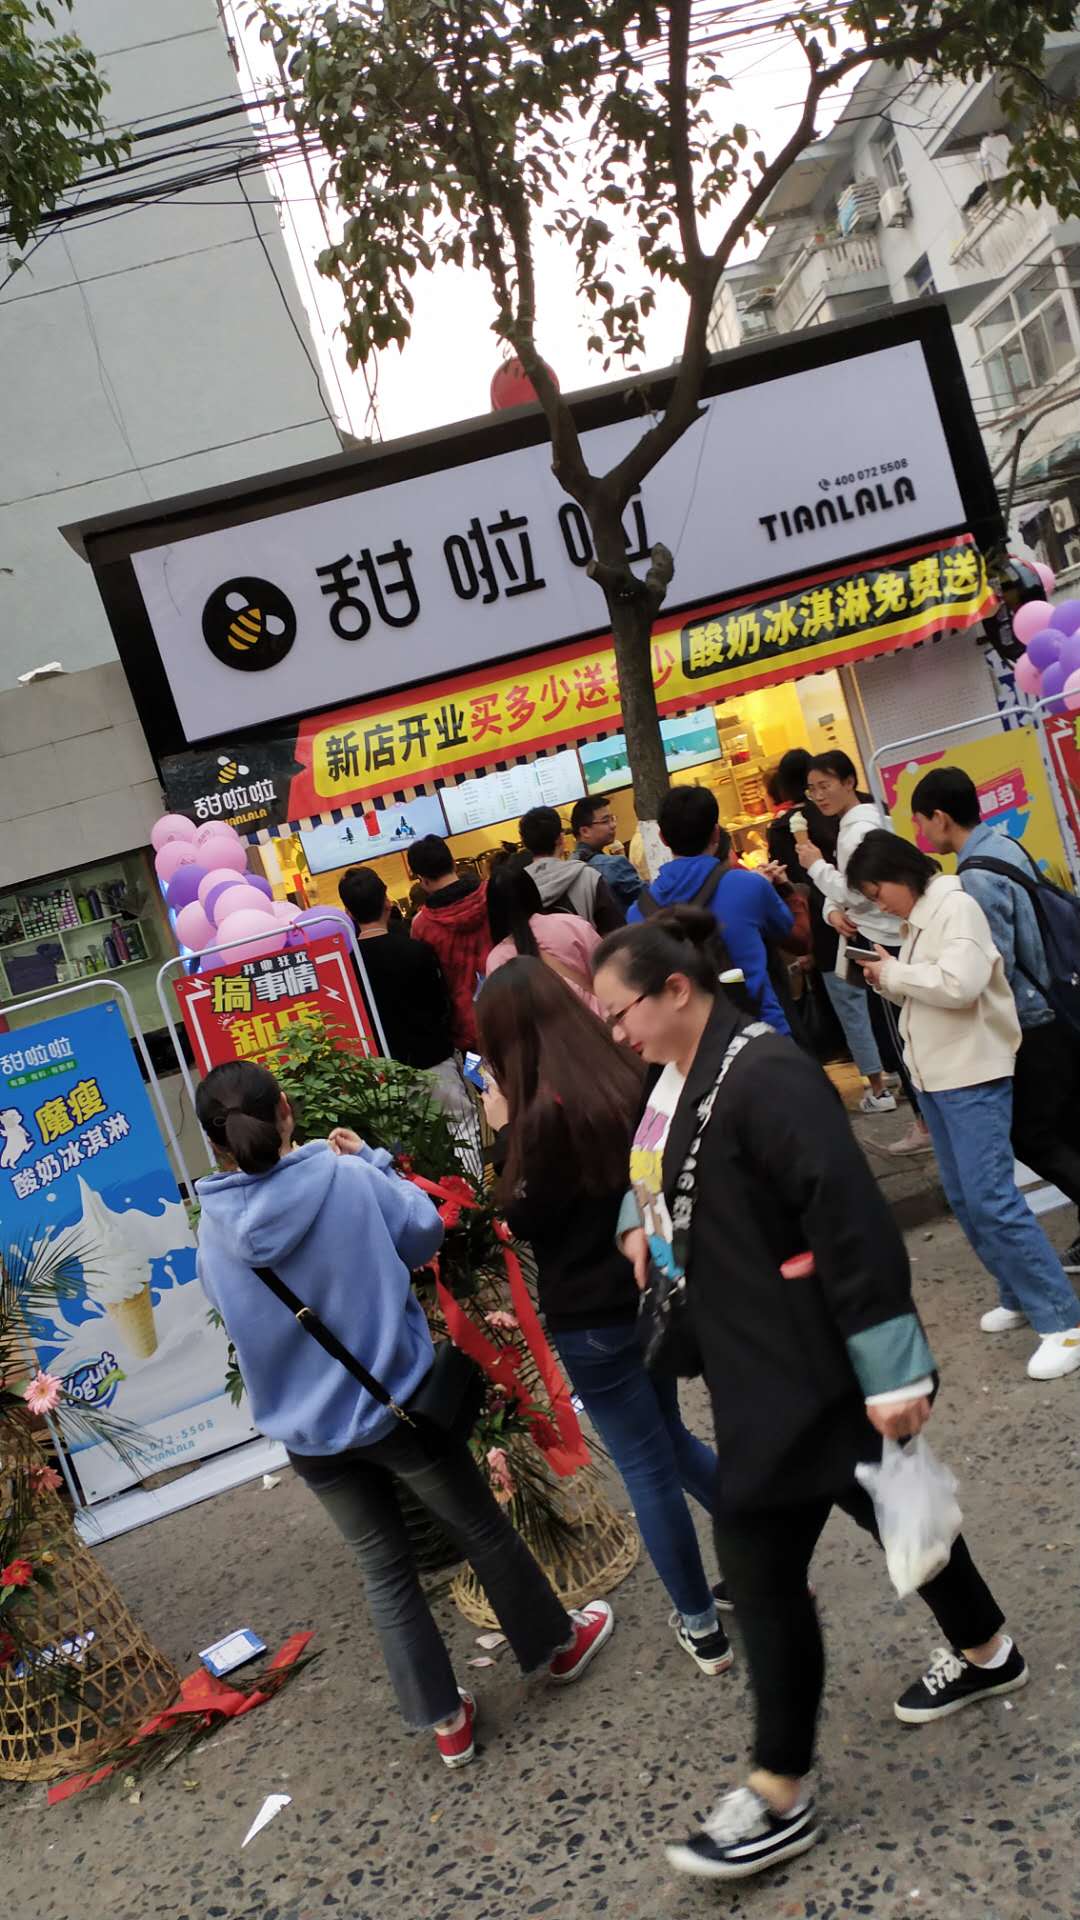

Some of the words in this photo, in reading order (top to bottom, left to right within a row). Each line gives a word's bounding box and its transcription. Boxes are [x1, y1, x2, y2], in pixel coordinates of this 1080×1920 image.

[834, 473, 856, 487] 400
[857, 466, 878, 481] 072
[880, 458, 909, 475] 5508
[758, 476, 917, 542] TIANLALA
[688, 549, 979, 672] 酸奶冰淇淋免费送
[193, 778, 278, 819] 甜啦啦
[0, 1036, 75, 1075] 甜啦啦
[35, 1078, 107, 1144] 魔瘦
[11, 1111, 131, 1200] 酸奶冰淇淋
